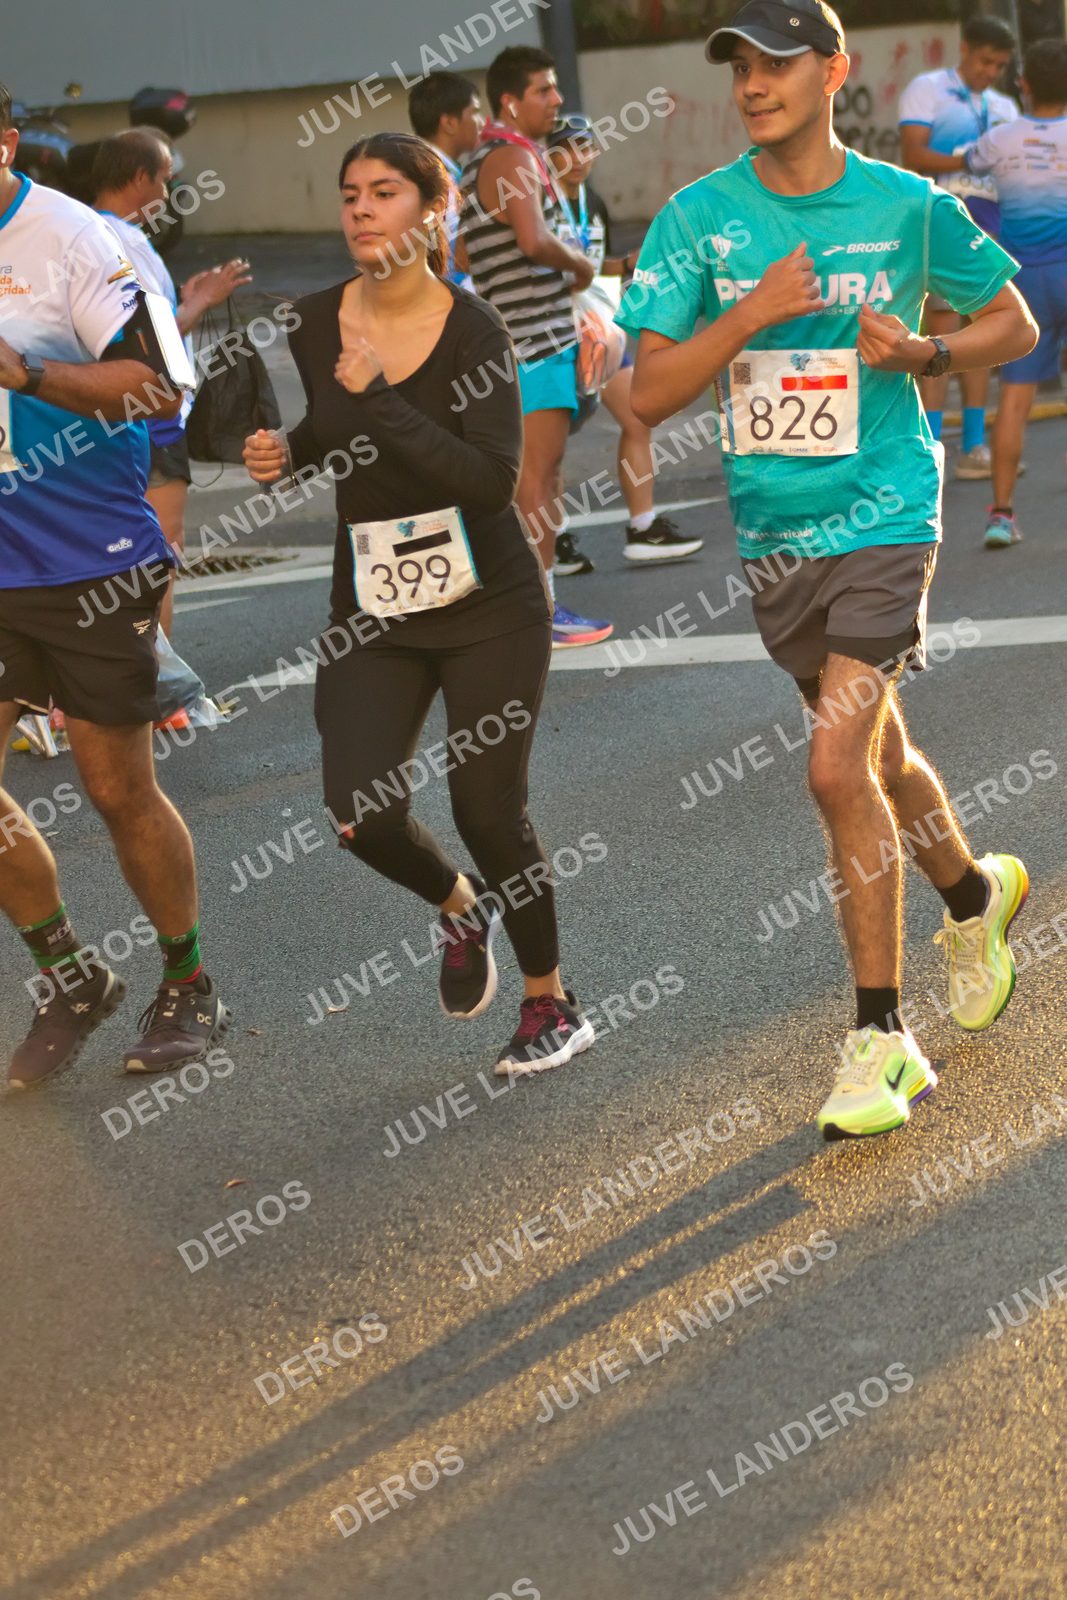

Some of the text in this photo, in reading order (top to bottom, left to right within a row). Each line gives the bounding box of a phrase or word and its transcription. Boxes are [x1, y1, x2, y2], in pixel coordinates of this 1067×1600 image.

[846, 240, 900, 254] BROOKS
[749, 395, 838, 441] 826
[370, 554, 451, 604] 399
